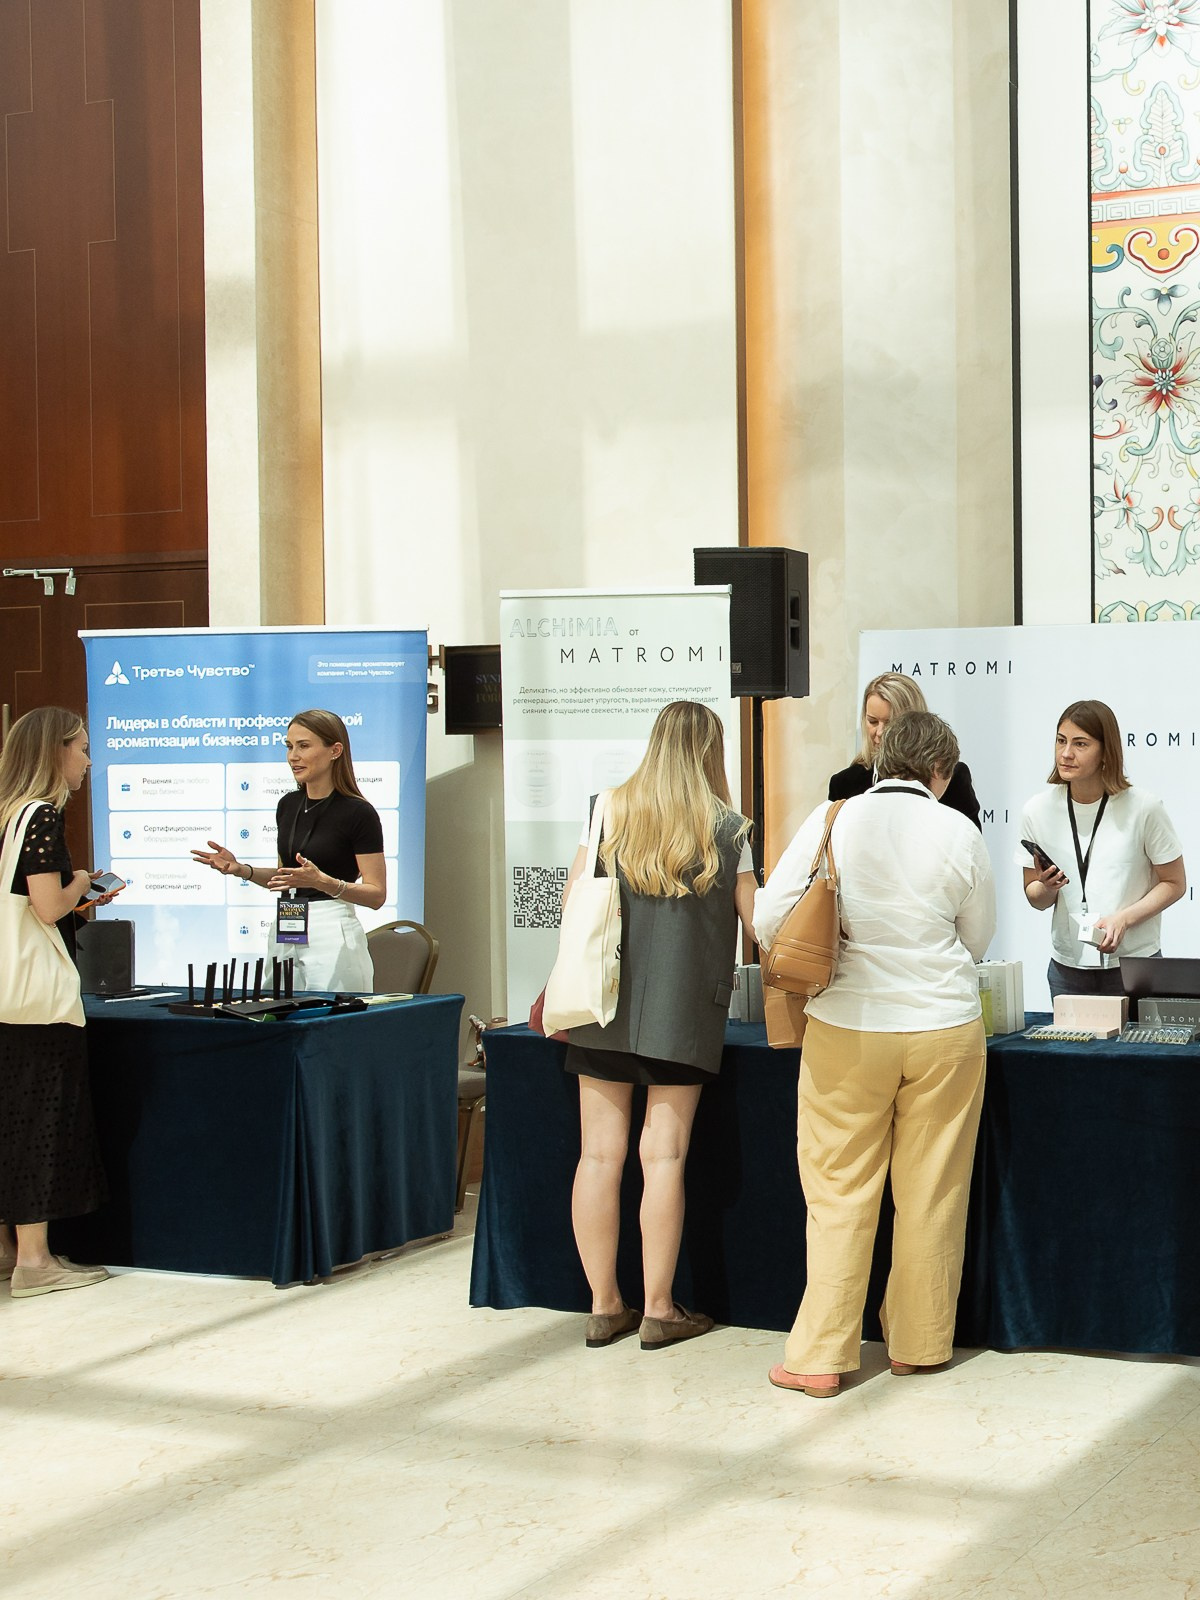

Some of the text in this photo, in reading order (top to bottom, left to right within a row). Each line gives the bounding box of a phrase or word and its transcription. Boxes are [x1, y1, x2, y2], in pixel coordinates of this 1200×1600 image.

[560, 645, 723, 664] MATROMI
[131, 665, 184, 681] Третье
[891, 660, 1012, 676] MATROMI
[519, 686, 559, 694] Деликатно,
[570, 686, 610, 694] эффективно
[596, 697, 631, 705] упругость,
[106, 716, 159, 732] Лидеры
[161, 718, 169, 729] в
[171, 715, 226, 729] области
[106, 736, 200, 750] ароматизации
[202, 733, 258, 747] бизнеса
[261, 735, 270, 745] в
[1127, 732, 1196, 747] ROMI
[142, 777, 172, 785] Решения
[143, 825, 212, 833] Сертифицированное
[1145, 1014, 1200, 1023] MATROMI
